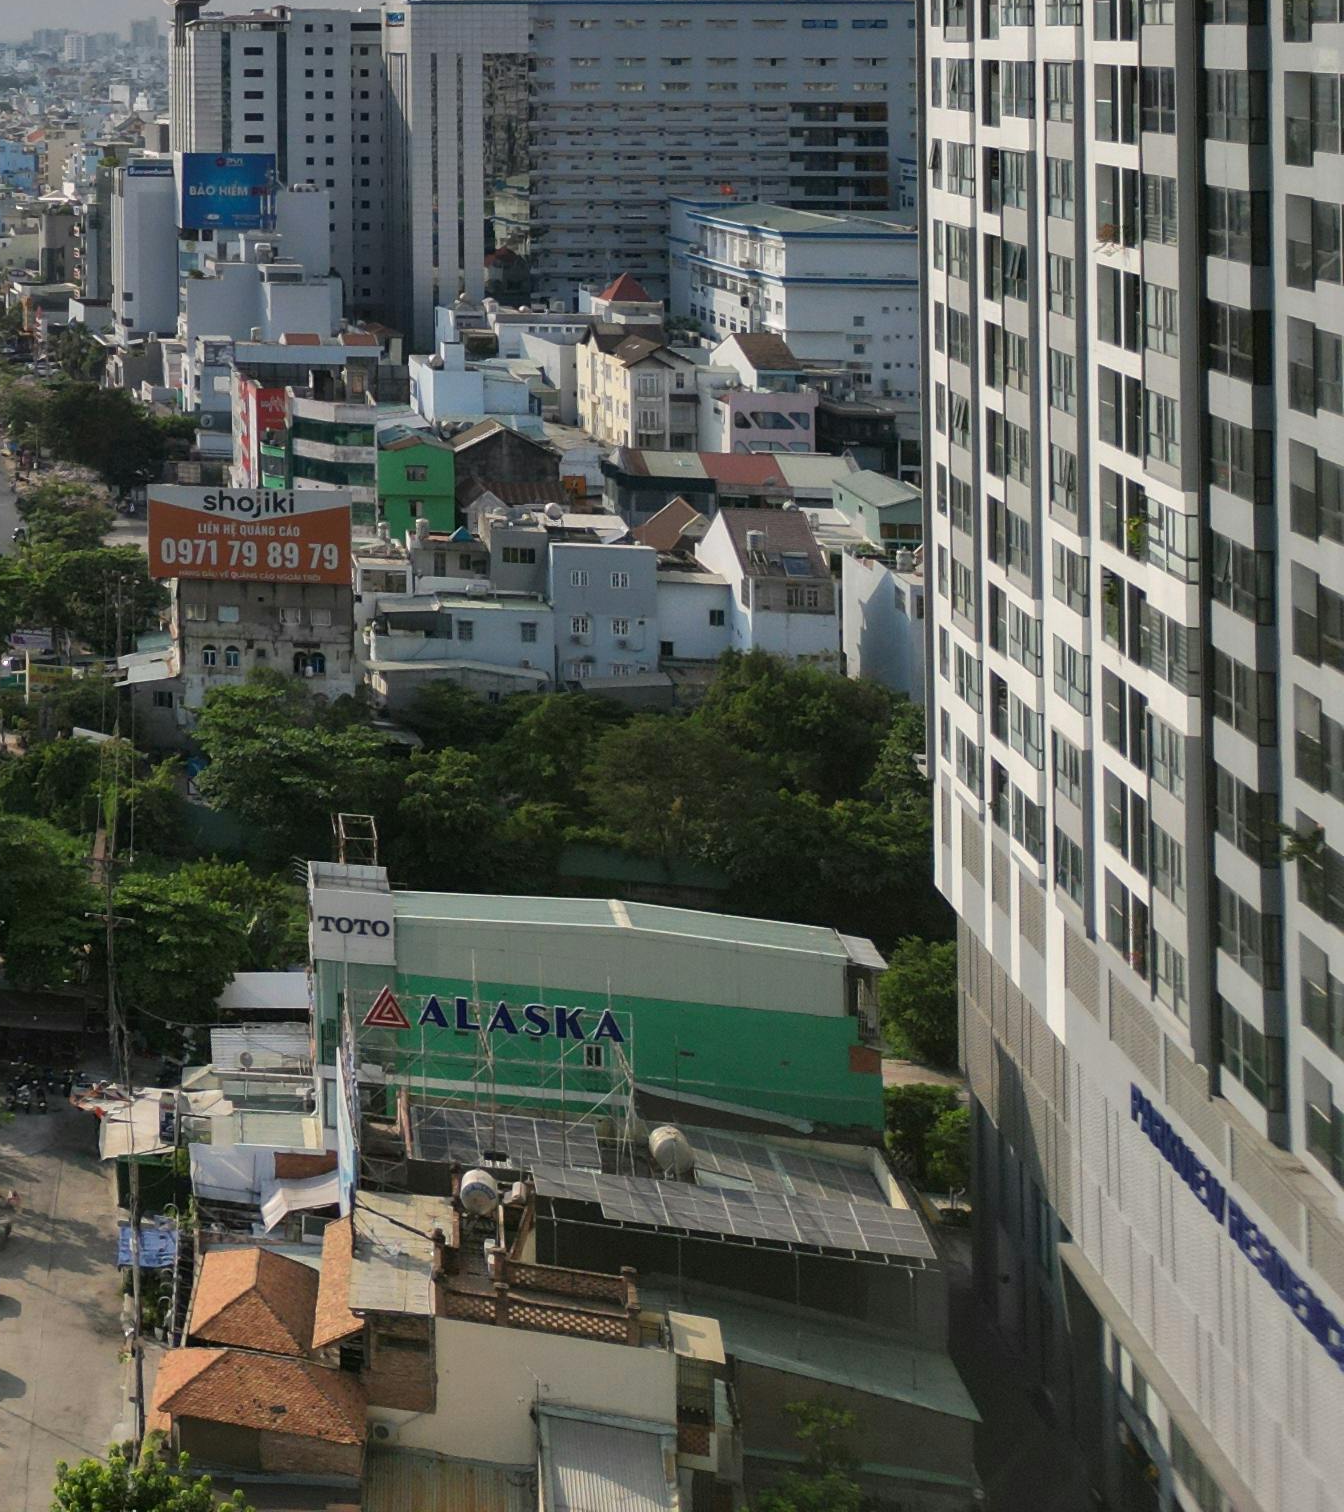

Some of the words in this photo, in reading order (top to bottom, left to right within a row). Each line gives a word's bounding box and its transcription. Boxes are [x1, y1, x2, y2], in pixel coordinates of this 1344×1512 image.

[203, 490, 294, 518] shojiki
[223, 522, 237, 536] HỆ
[239, 523, 276, 536] QUẢNG
[279, 524, 300, 536] CÁO
[161, 537, 218, 566] 0971
[227, 540, 257, 567] 79
[267, 541, 299, 569] 89
[308, 543, 339, 570] 79
[318, 915, 390, 937] TOTO
[417, 993, 625, 1043] ALASKA
